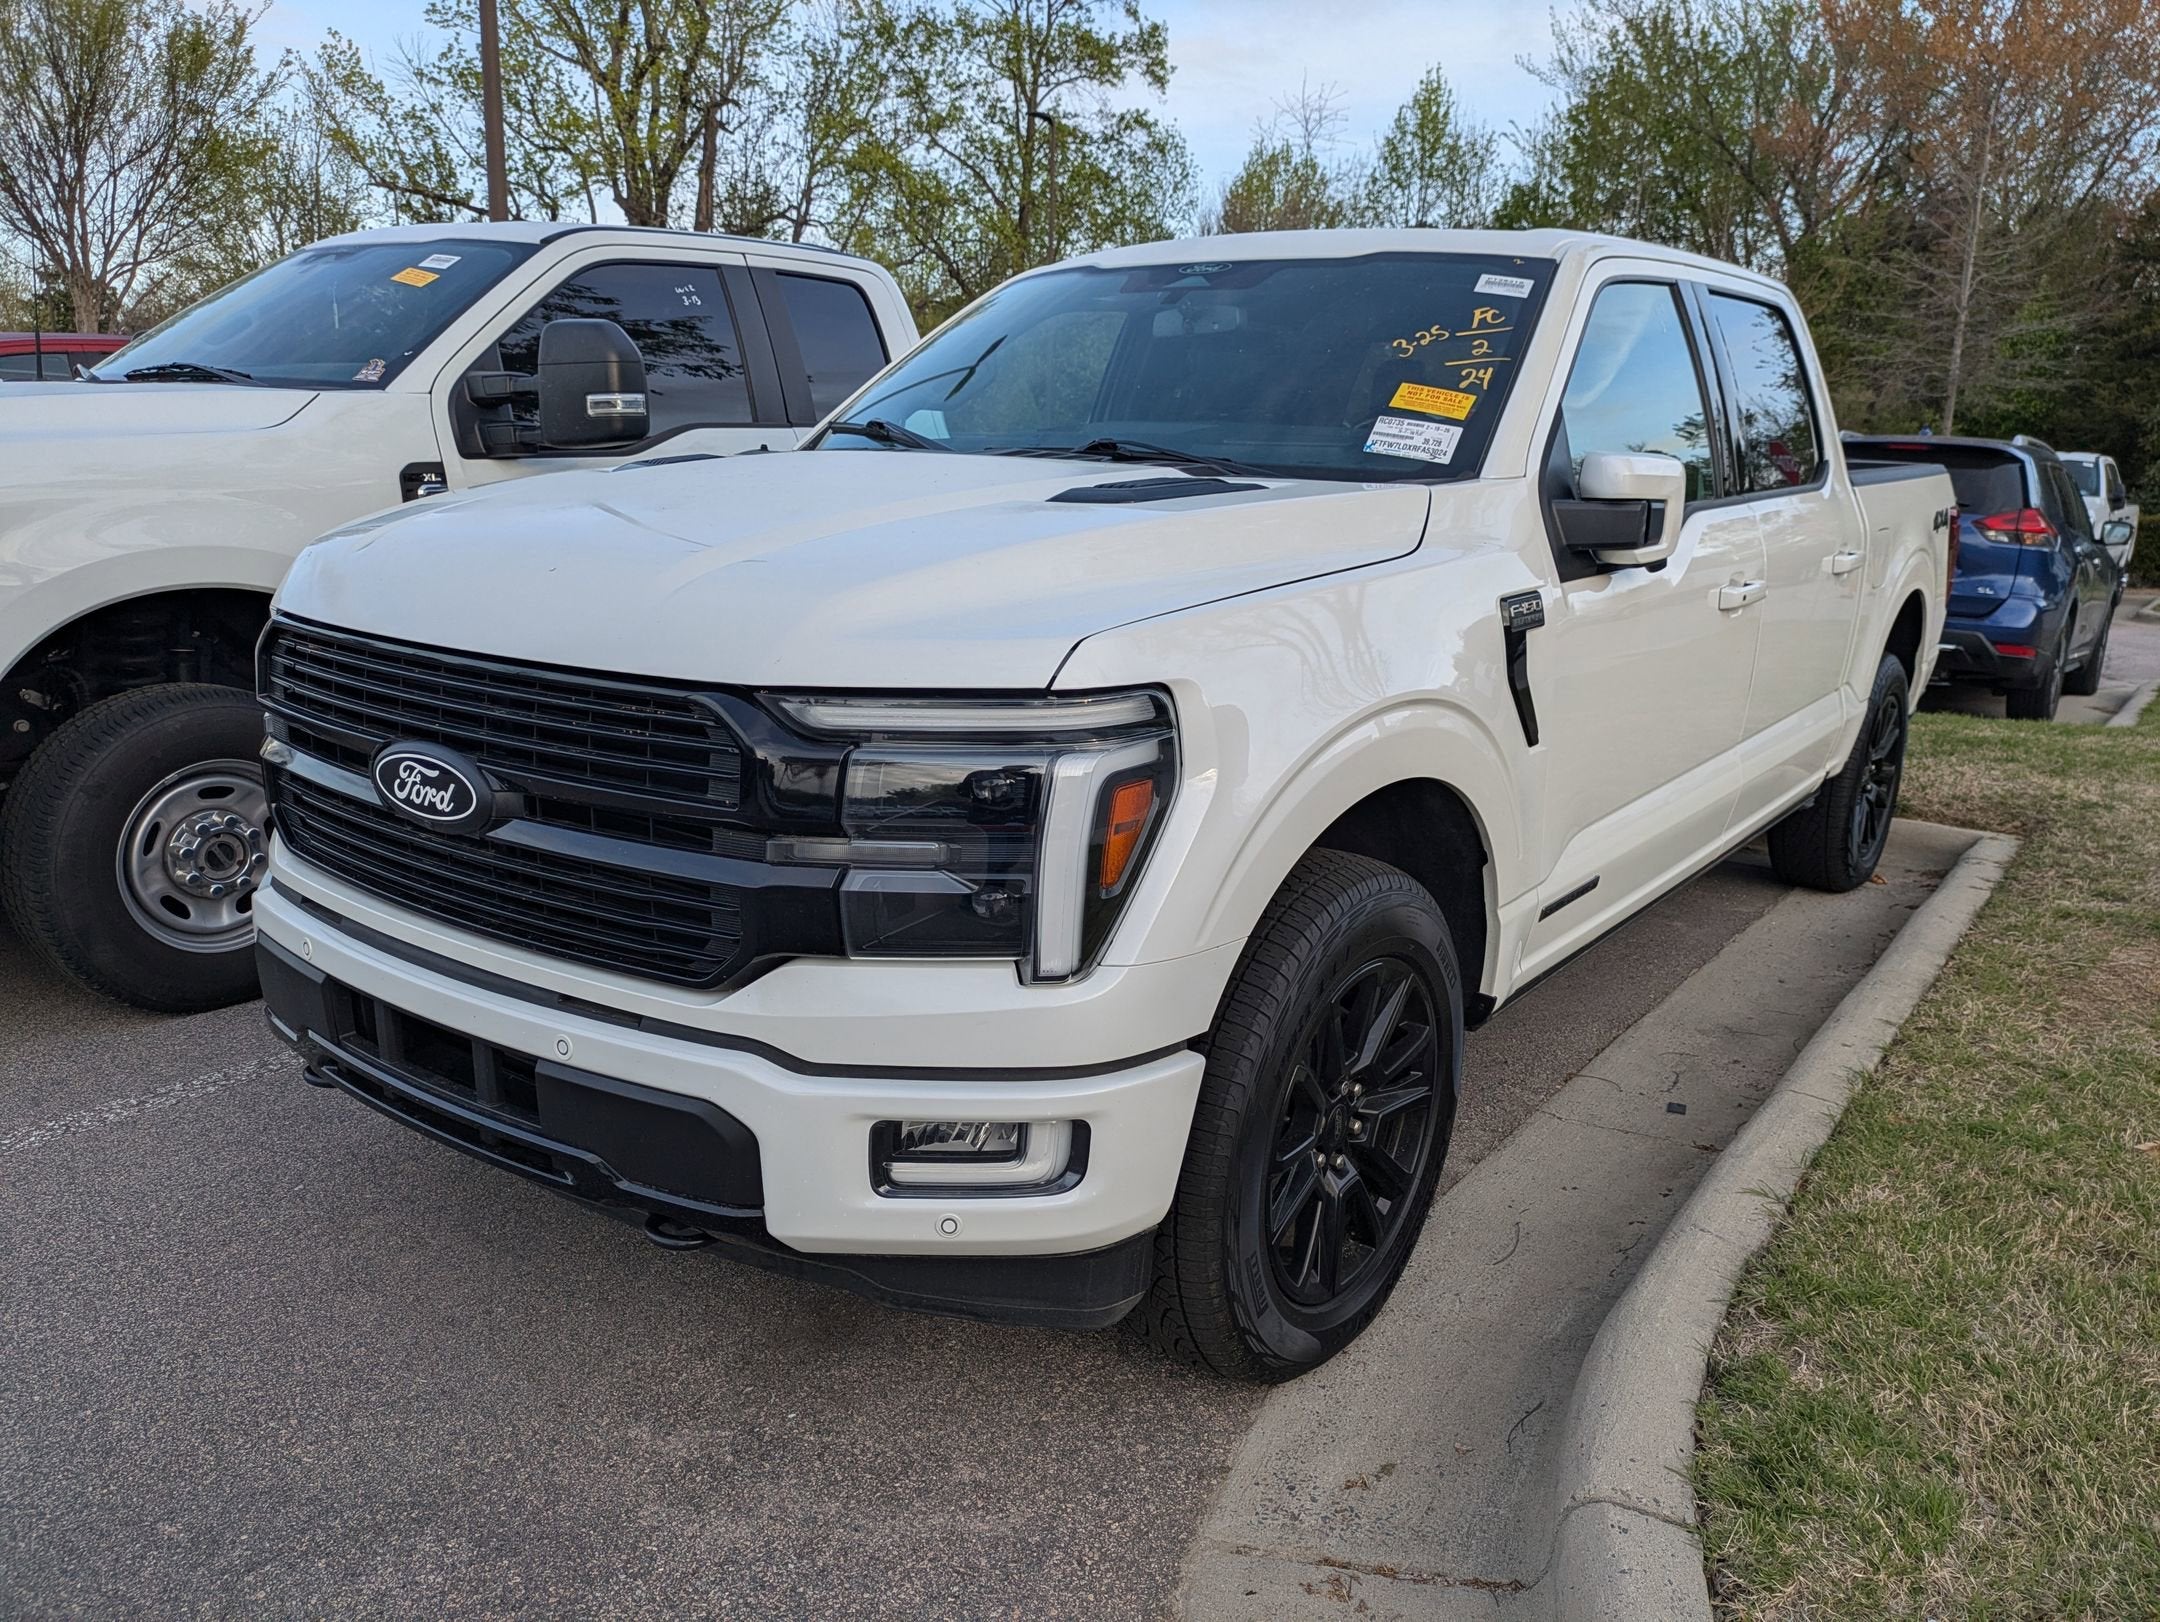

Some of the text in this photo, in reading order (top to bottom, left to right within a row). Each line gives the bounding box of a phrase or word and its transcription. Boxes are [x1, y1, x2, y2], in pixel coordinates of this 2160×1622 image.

[1472, 339, 1493, 356] 2
[1459, 367, 1494, 390] 24
[1406, 390, 1424, 398] NOT
[1425, 393, 1441, 401] FOR
[1443, 395, 1463, 405] SALE
[1427, 388, 1460, 398] VEHICLE
[422, 473, 442, 482] XL
[1977, 586, 1995, 595] SL
[393, 760, 456, 813] Ford
